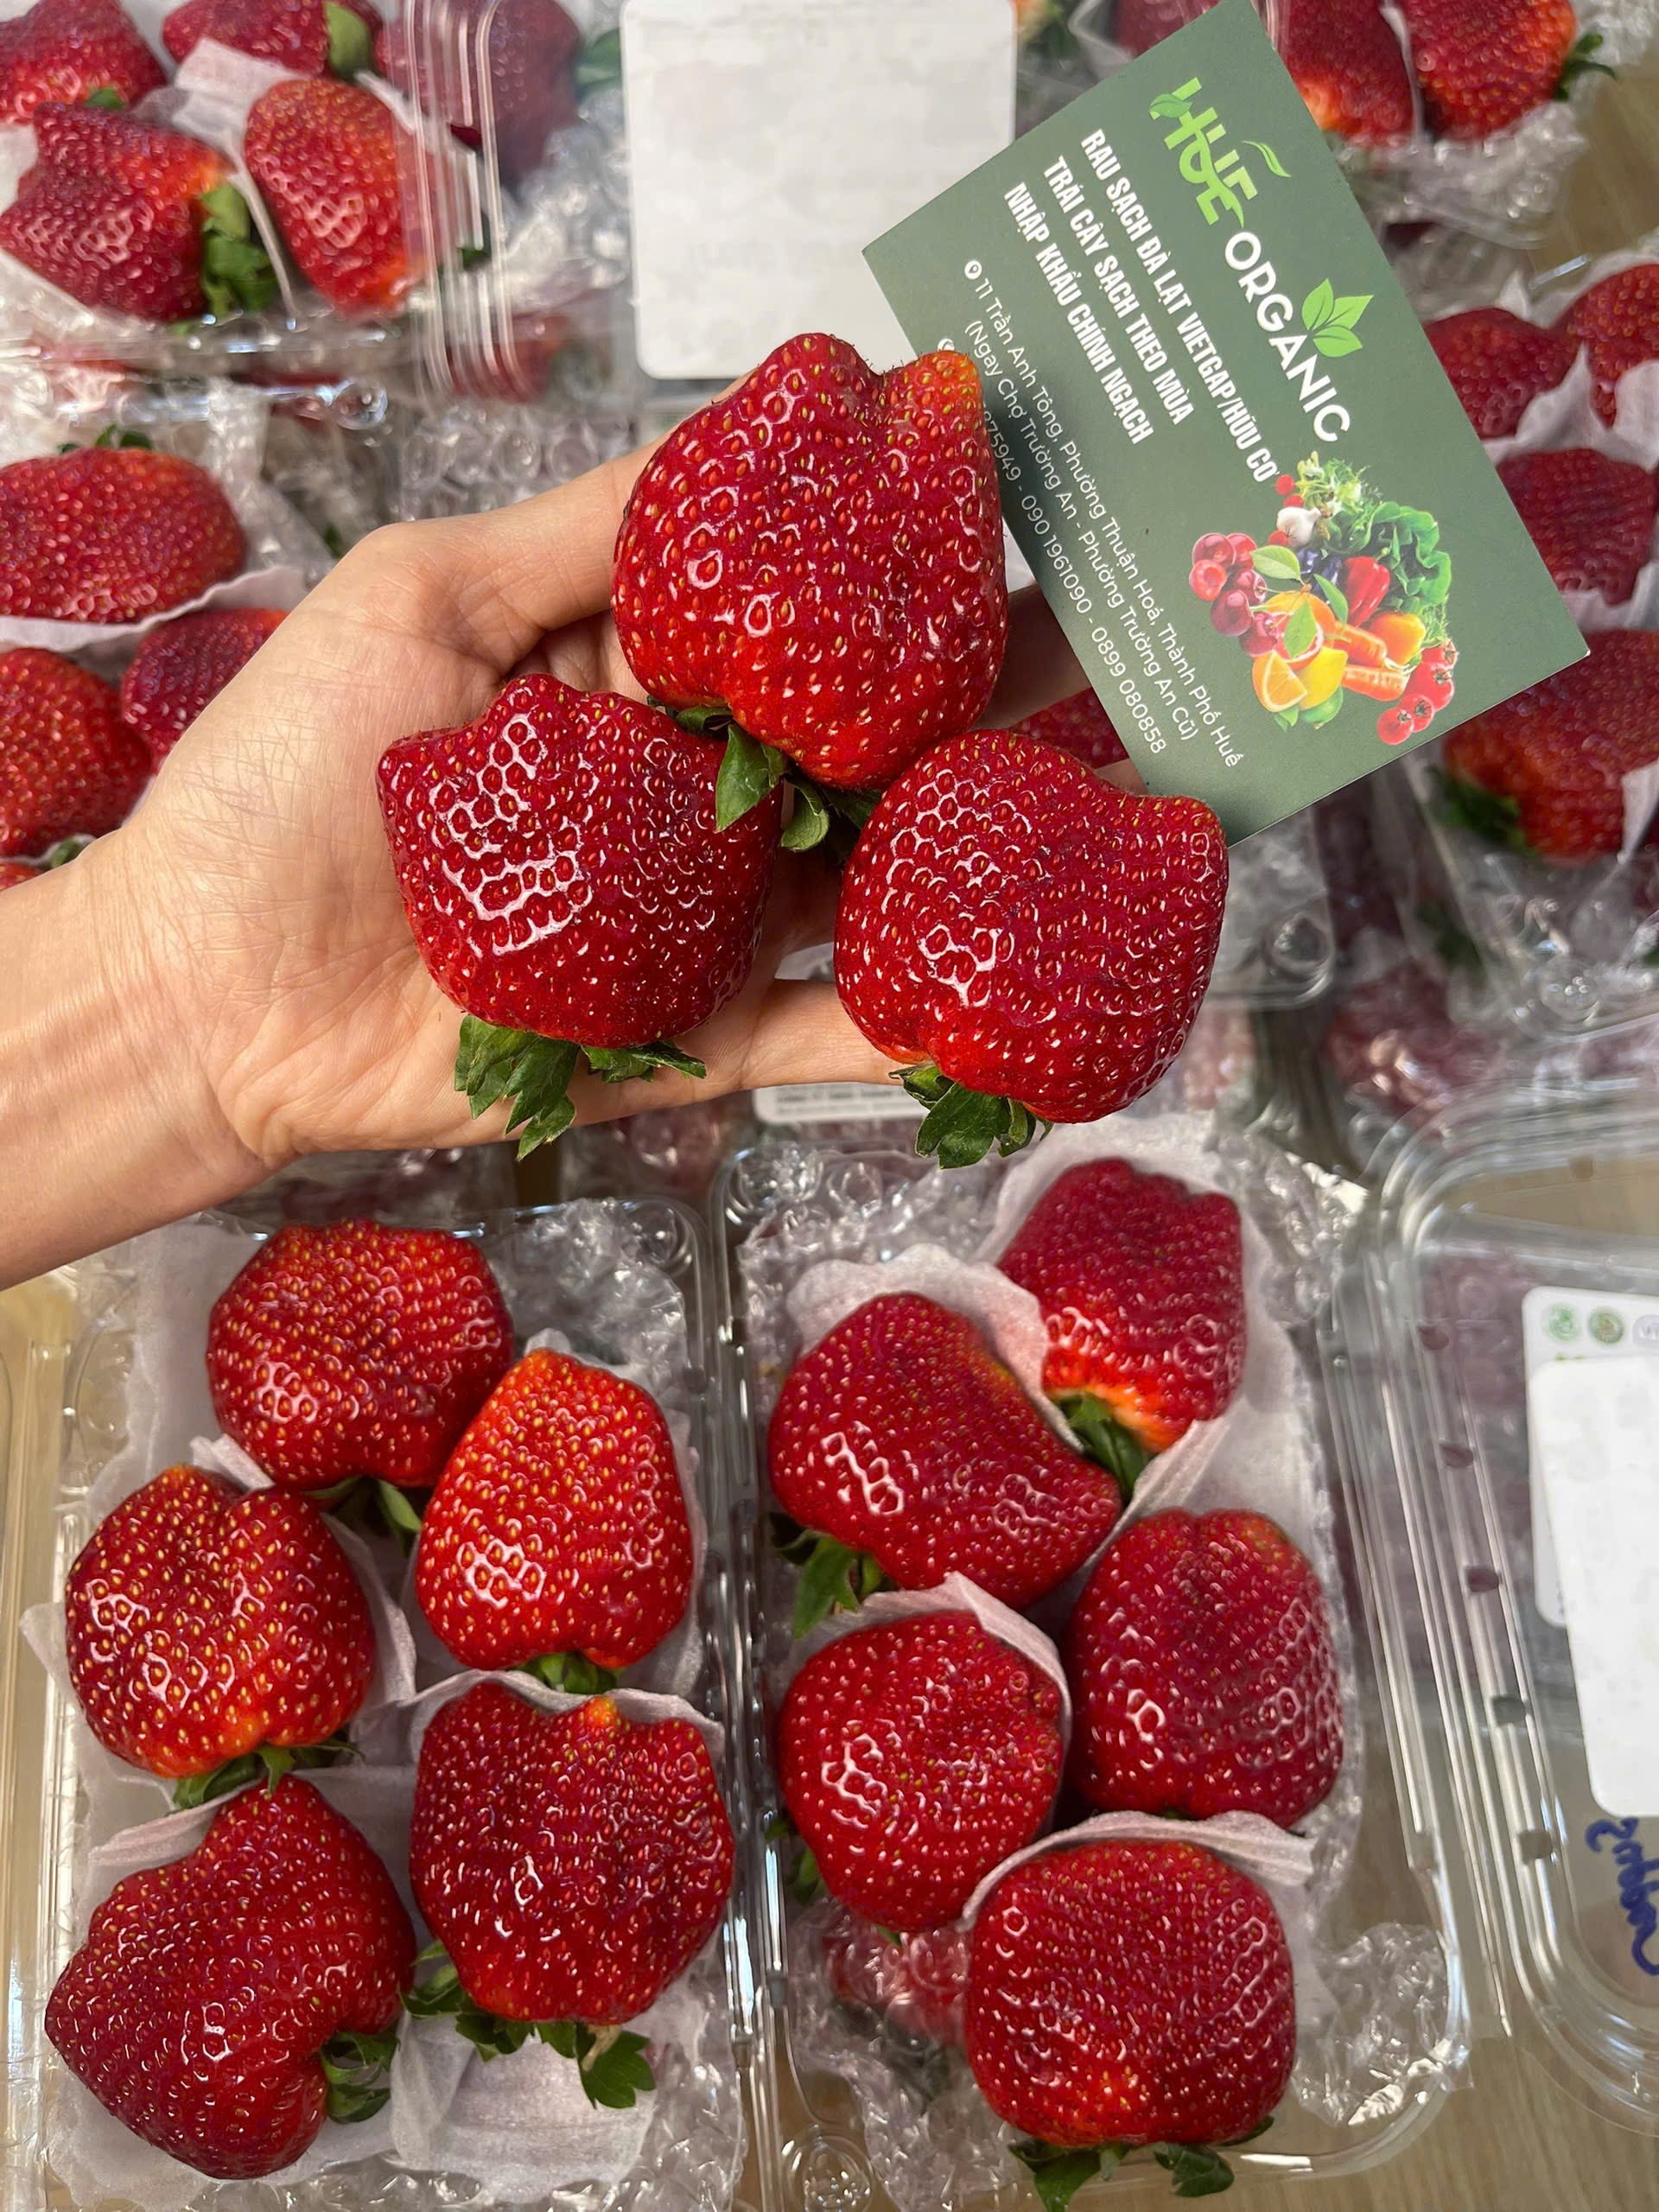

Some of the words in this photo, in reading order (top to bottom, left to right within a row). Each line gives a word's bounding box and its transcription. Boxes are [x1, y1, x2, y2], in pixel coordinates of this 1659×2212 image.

[1080, 128, 1122, 181] RAU
[1105, 176, 1153, 242] SẠCH
[1135, 235, 1172, 276] ĐÀ
[975, 277, 994, 300] 11
[1003, 181, 1051, 243] NHẬP
[1035, 242, 1083, 307] KHẨU
[1066, 302, 1116, 373] CHÍNH
[1100, 366, 1154, 445] NGẠCH
[1043, 155, 1085, 214] TRÁI
[1070, 208, 1109, 257] CÂY
[1094, 254, 1141, 319] SẠCH
[1124, 312, 1168, 372] THEO
[1152, 367, 1195, 425] MÙA
[1153, 269, 1192, 315] LẠT
[985, 296, 1014, 346] Trần
[1224, 231, 1351, 442] ORGANIC
[1007, 346, 1038, 388] Anh
[1032, 385, 1064, 442] Tông,
[1058, 440, 1107, 520] Phường
[1246, 447, 1281, 482] CƠ
[964, 320, 1003, 377] (Ngay
[997, 378, 1027, 419] Chợ
[1020, 417, 1062, 491] Trường
[1054, 492, 1077, 520] An
[1077, 530, 1125, 609] Phường
[1119, 605, 1162, 677] Trường
[1154, 678, 1177, 706] An
[1172, 706, 1198, 741] Cũ)
[1101, 516, 1139, 580] Thuận
[1020, 494, 1051, 535] 090
[1043, 534, 1093, 613] 1961090
[1091, 626, 1127, 677] 0899
[1119, 678, 1167, 754] 080858
[1133, 578, 1165, 626] Hoá,
[1147, 622, 1196, 686] Thành
[1185, 683, 1222, 732] Phố
[1210, 725, 1244, 767] Huế
